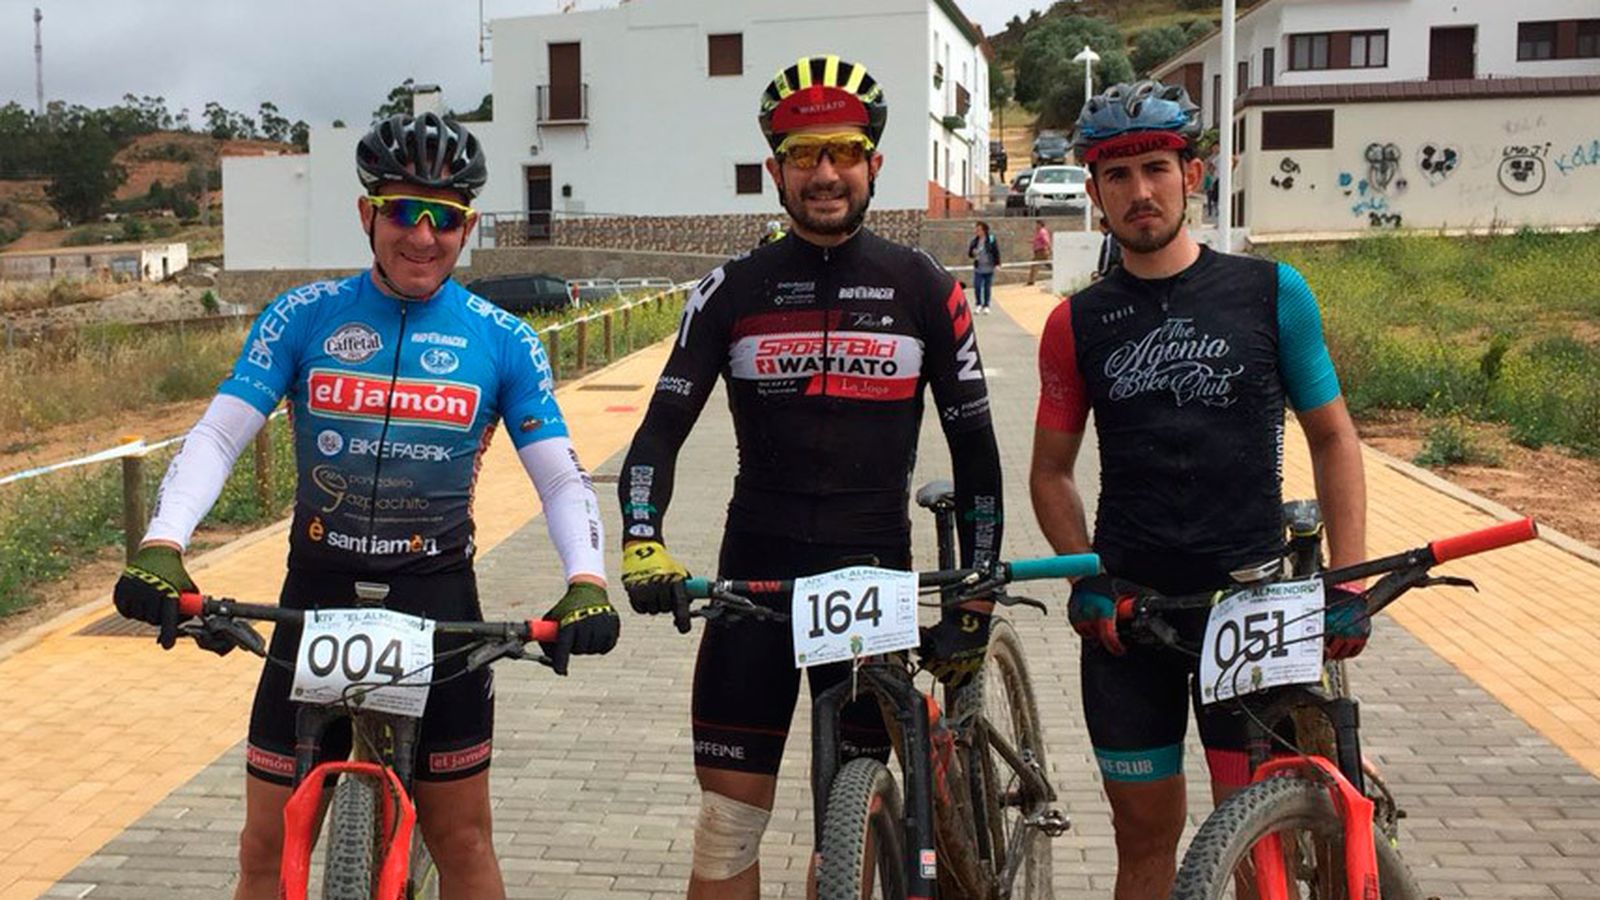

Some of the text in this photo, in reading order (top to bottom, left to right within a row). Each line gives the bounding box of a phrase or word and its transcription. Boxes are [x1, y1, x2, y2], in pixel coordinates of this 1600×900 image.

[779, 357, 898, 377] WATIATO
[1104, 328, 1231, 379] Agonia
[315, 378, 467, 416] el jamón
[1109, 366, 1240, 401] Bike Club
[349, 438, 454, 462] BIKE FABRIK
[808, 586, 883, 639] 164
[307, 633, 404, 682] 004
[1214, 610, 1289, 670] 051
[1116, 759, 1153, 776] CLUB
